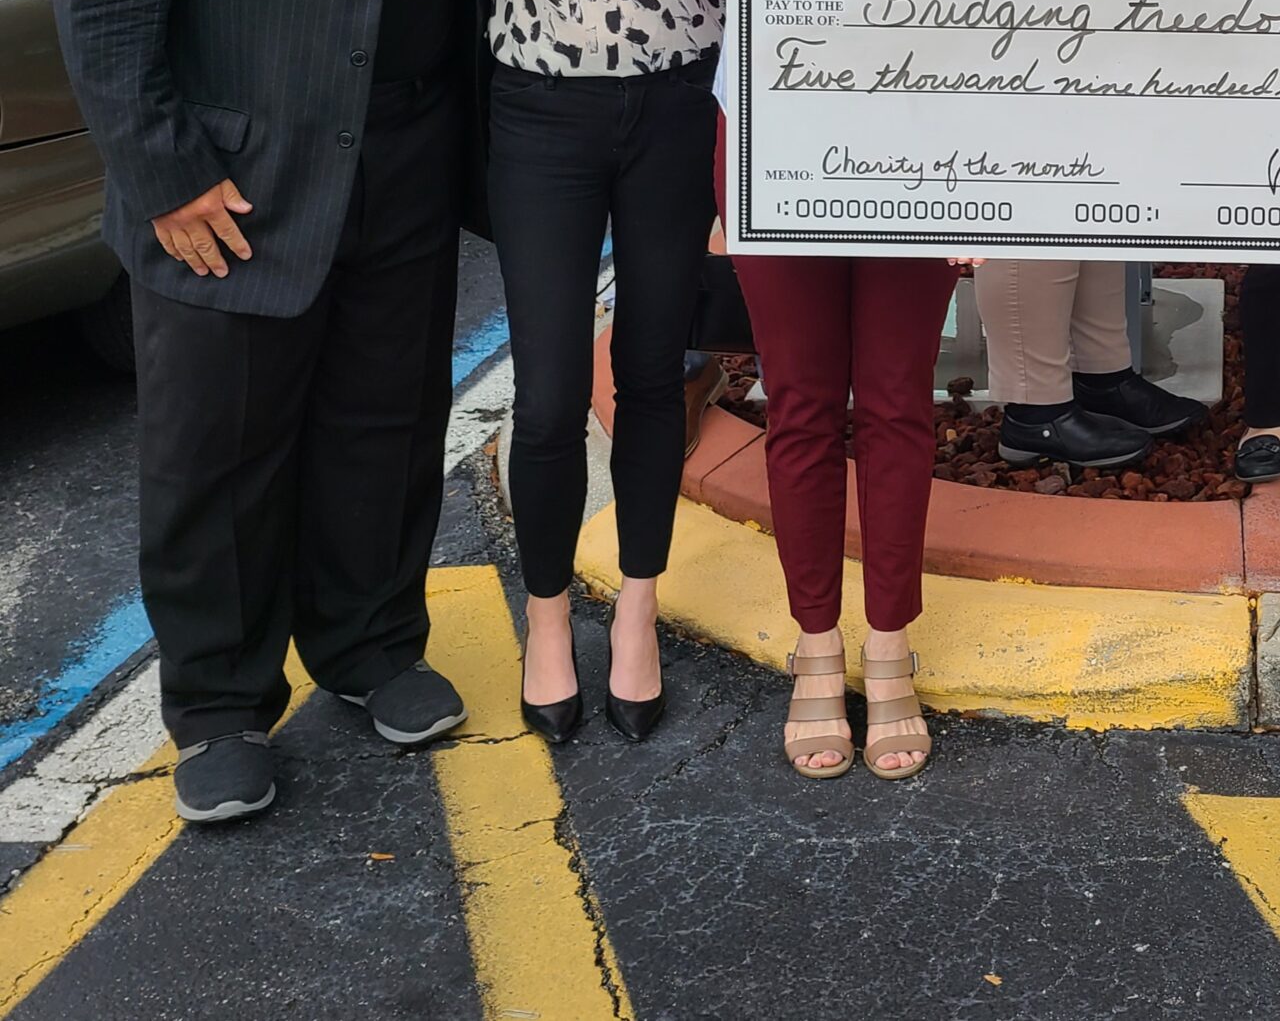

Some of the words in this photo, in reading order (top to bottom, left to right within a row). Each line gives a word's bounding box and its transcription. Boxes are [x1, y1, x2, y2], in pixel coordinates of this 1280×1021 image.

[765, 0, 789, 11] PAY
[793, 0, 812, 11] TO
[816, 0, 844, 12] THE
[764, 14, 813, 26] ORDER
[817, 15, 840, 27] OF:
[771, 37, 856, 91] Five
[866, 50, 1045, 94] thousand
[1054, 73, 1136, 97] nine
[1139, 67, 1280, 98] hundred
[765, 168, 815, 181] MEMO:
[822, 145, 924, 191] Charity
[932, 149, 958, 192] of
[963, 150, 1007, 177] the
[1011, 150, 1105, 179] month
